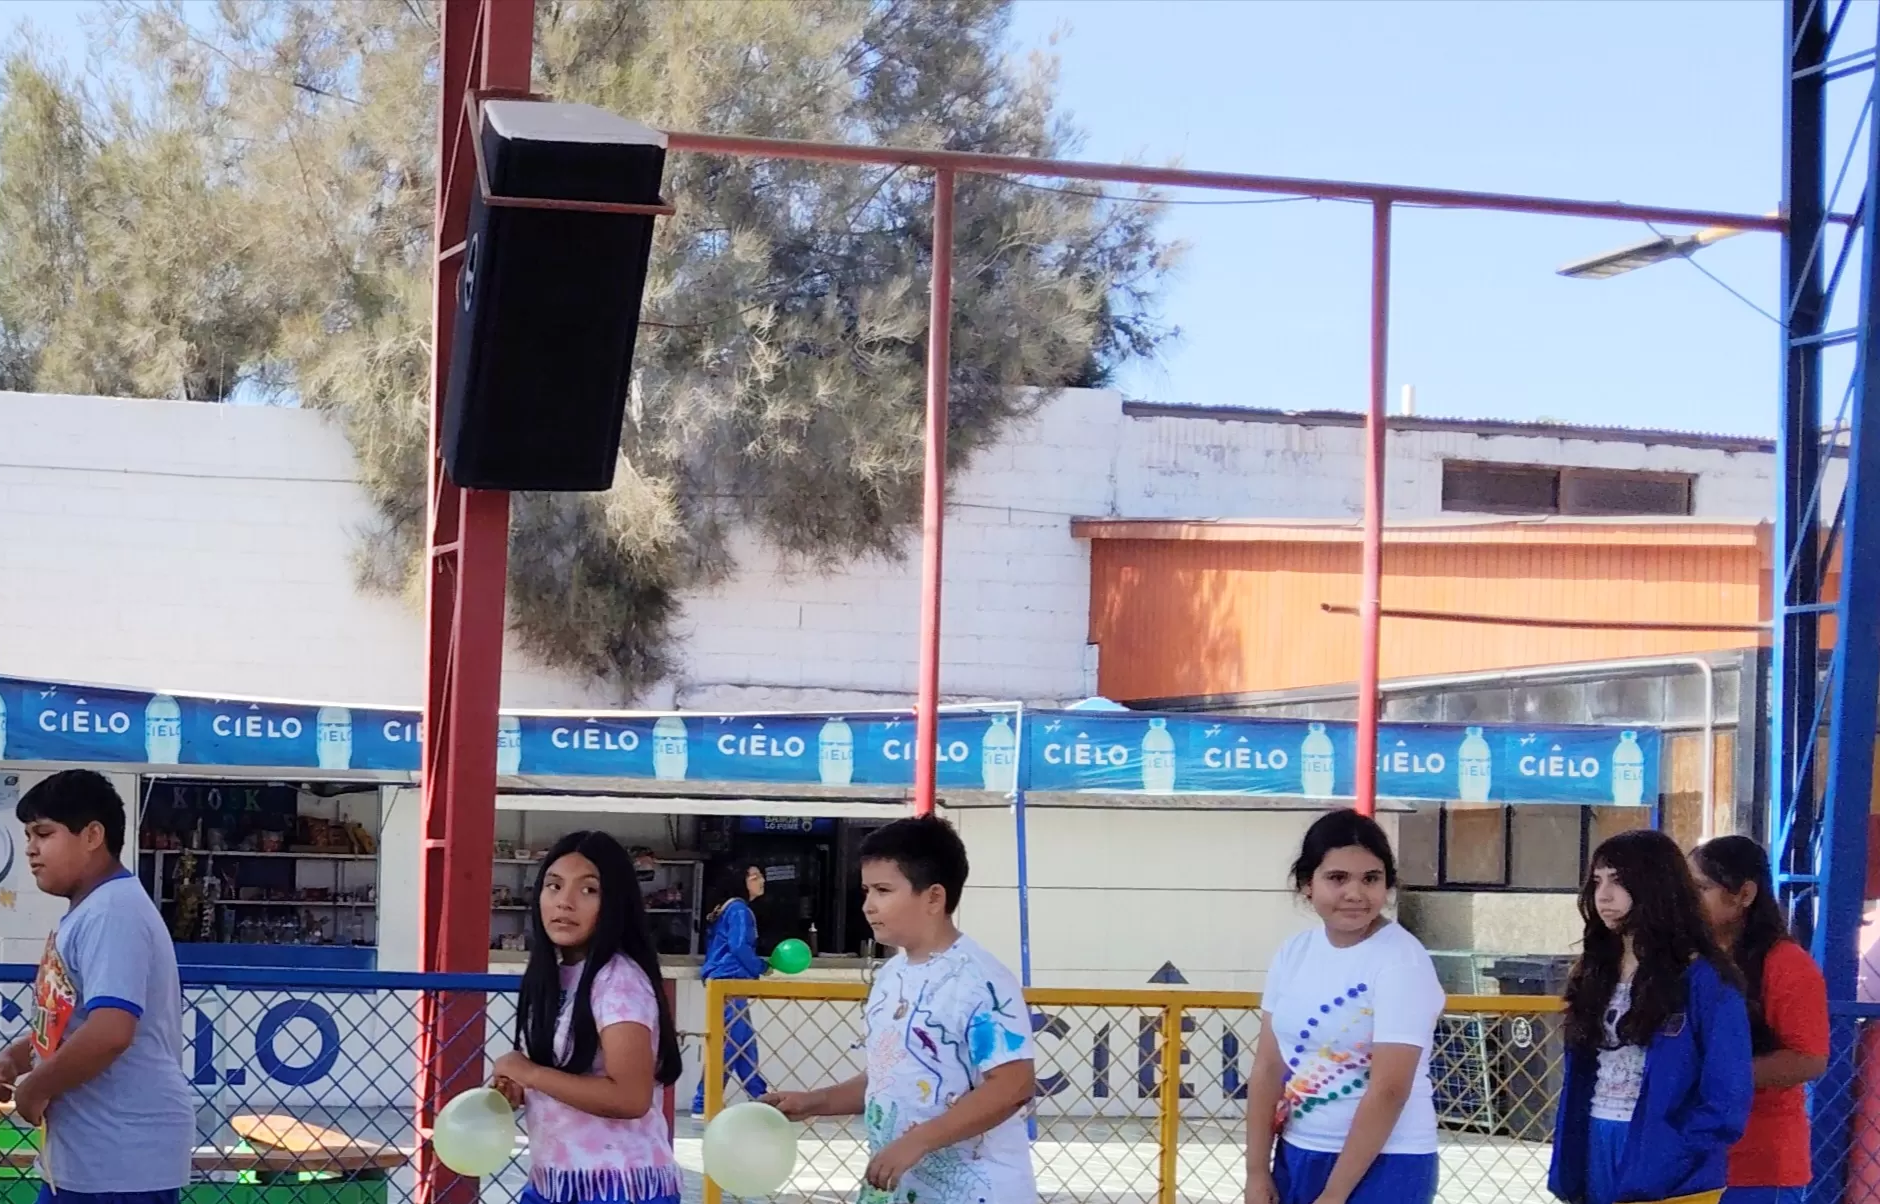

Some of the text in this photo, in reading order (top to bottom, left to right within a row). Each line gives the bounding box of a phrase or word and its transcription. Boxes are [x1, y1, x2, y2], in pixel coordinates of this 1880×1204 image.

[39, 709, 130, 733] CIELO
[212, 714, 302, 739] CIELO
[551, 727, 639, 751] CIELO
[717, 733, 805, 757] CIELO
[882, 739, 969, 762] CILO
[1044, 743, 1128, 766] CIELO
[1204, 747, 1288, 770] CIELO
[1376, 752, 1445, 774] IELO
[1520, 755, 1599, 778] CIELO
